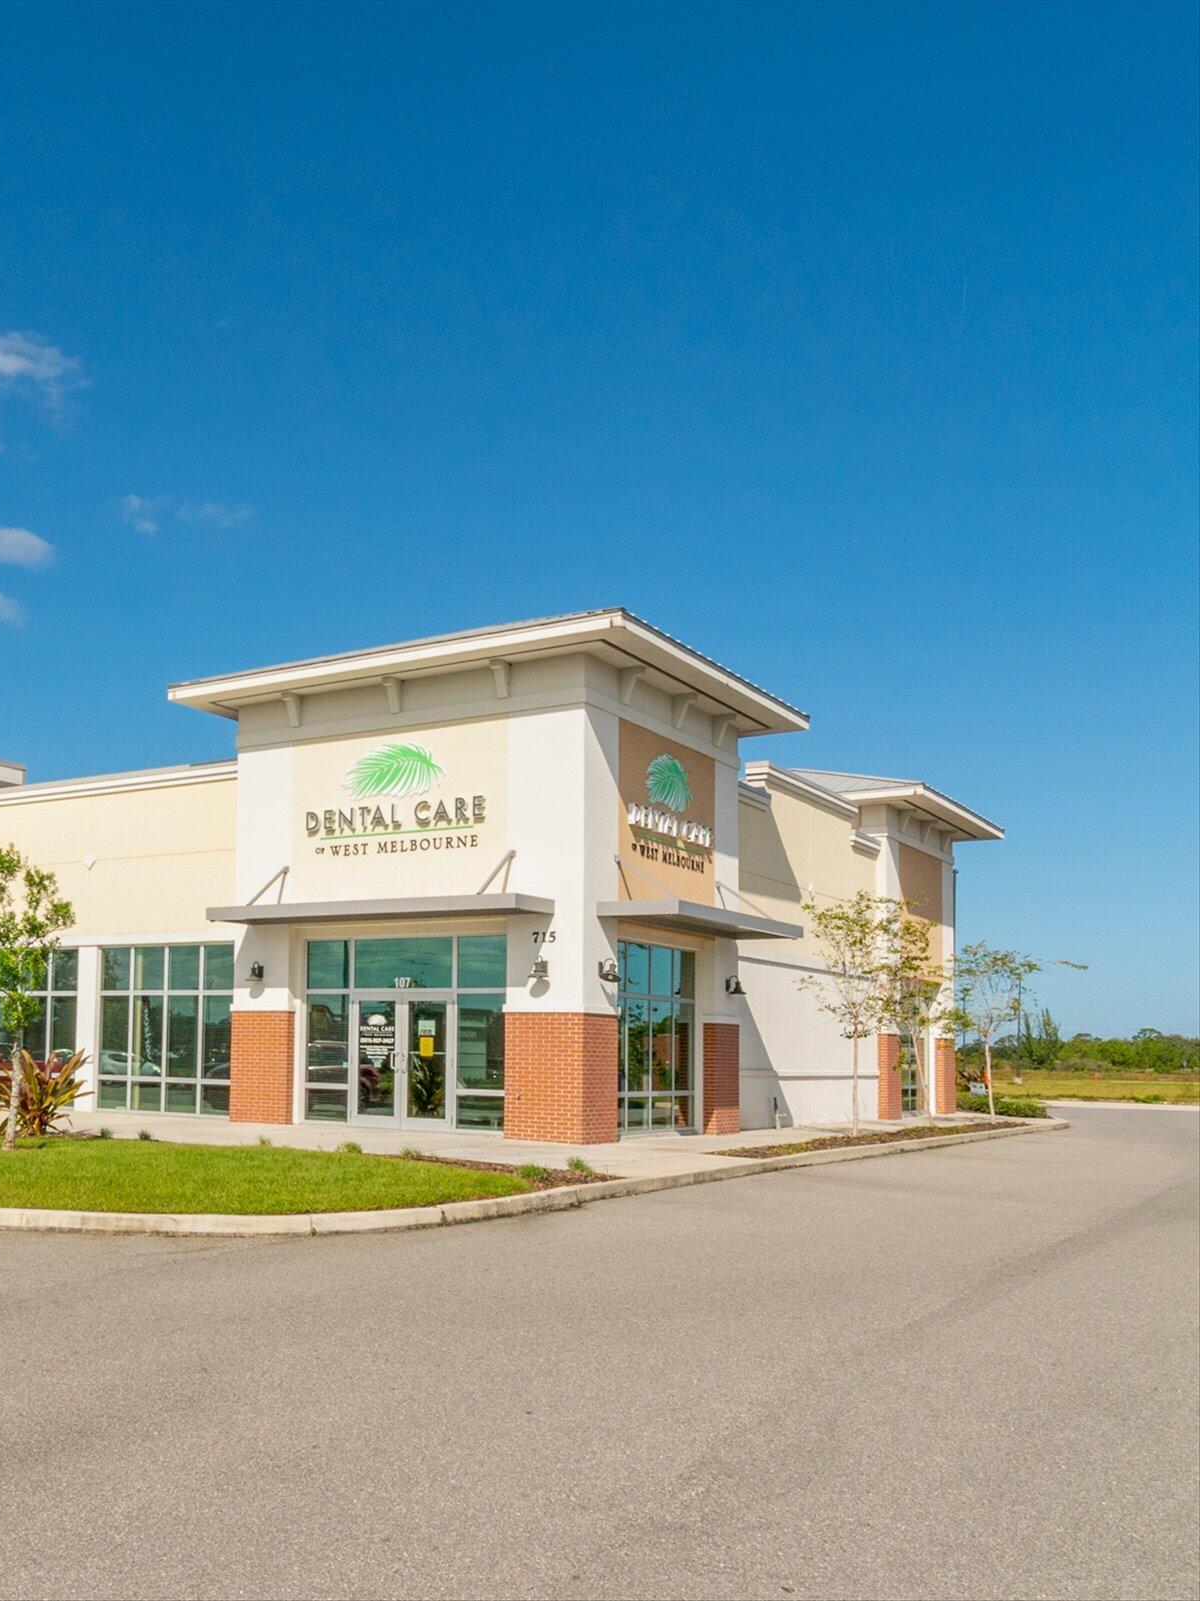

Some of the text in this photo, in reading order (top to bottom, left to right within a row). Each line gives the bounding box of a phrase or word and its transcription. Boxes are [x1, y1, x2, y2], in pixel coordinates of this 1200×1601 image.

[306, 795, 485, 834] DENTAL CARE
[627, 803, 713, 848] DENTAL CARE
[330, 842, 369, 857] WEST
[377, 834, 479, 854] MELBOURNE
[639, 845, 659, 860] WEST
[662, 850, 705, 874] MELBOURNE
[532, 931, 556, 943] 715
[394, 977, 411, 988] 107
